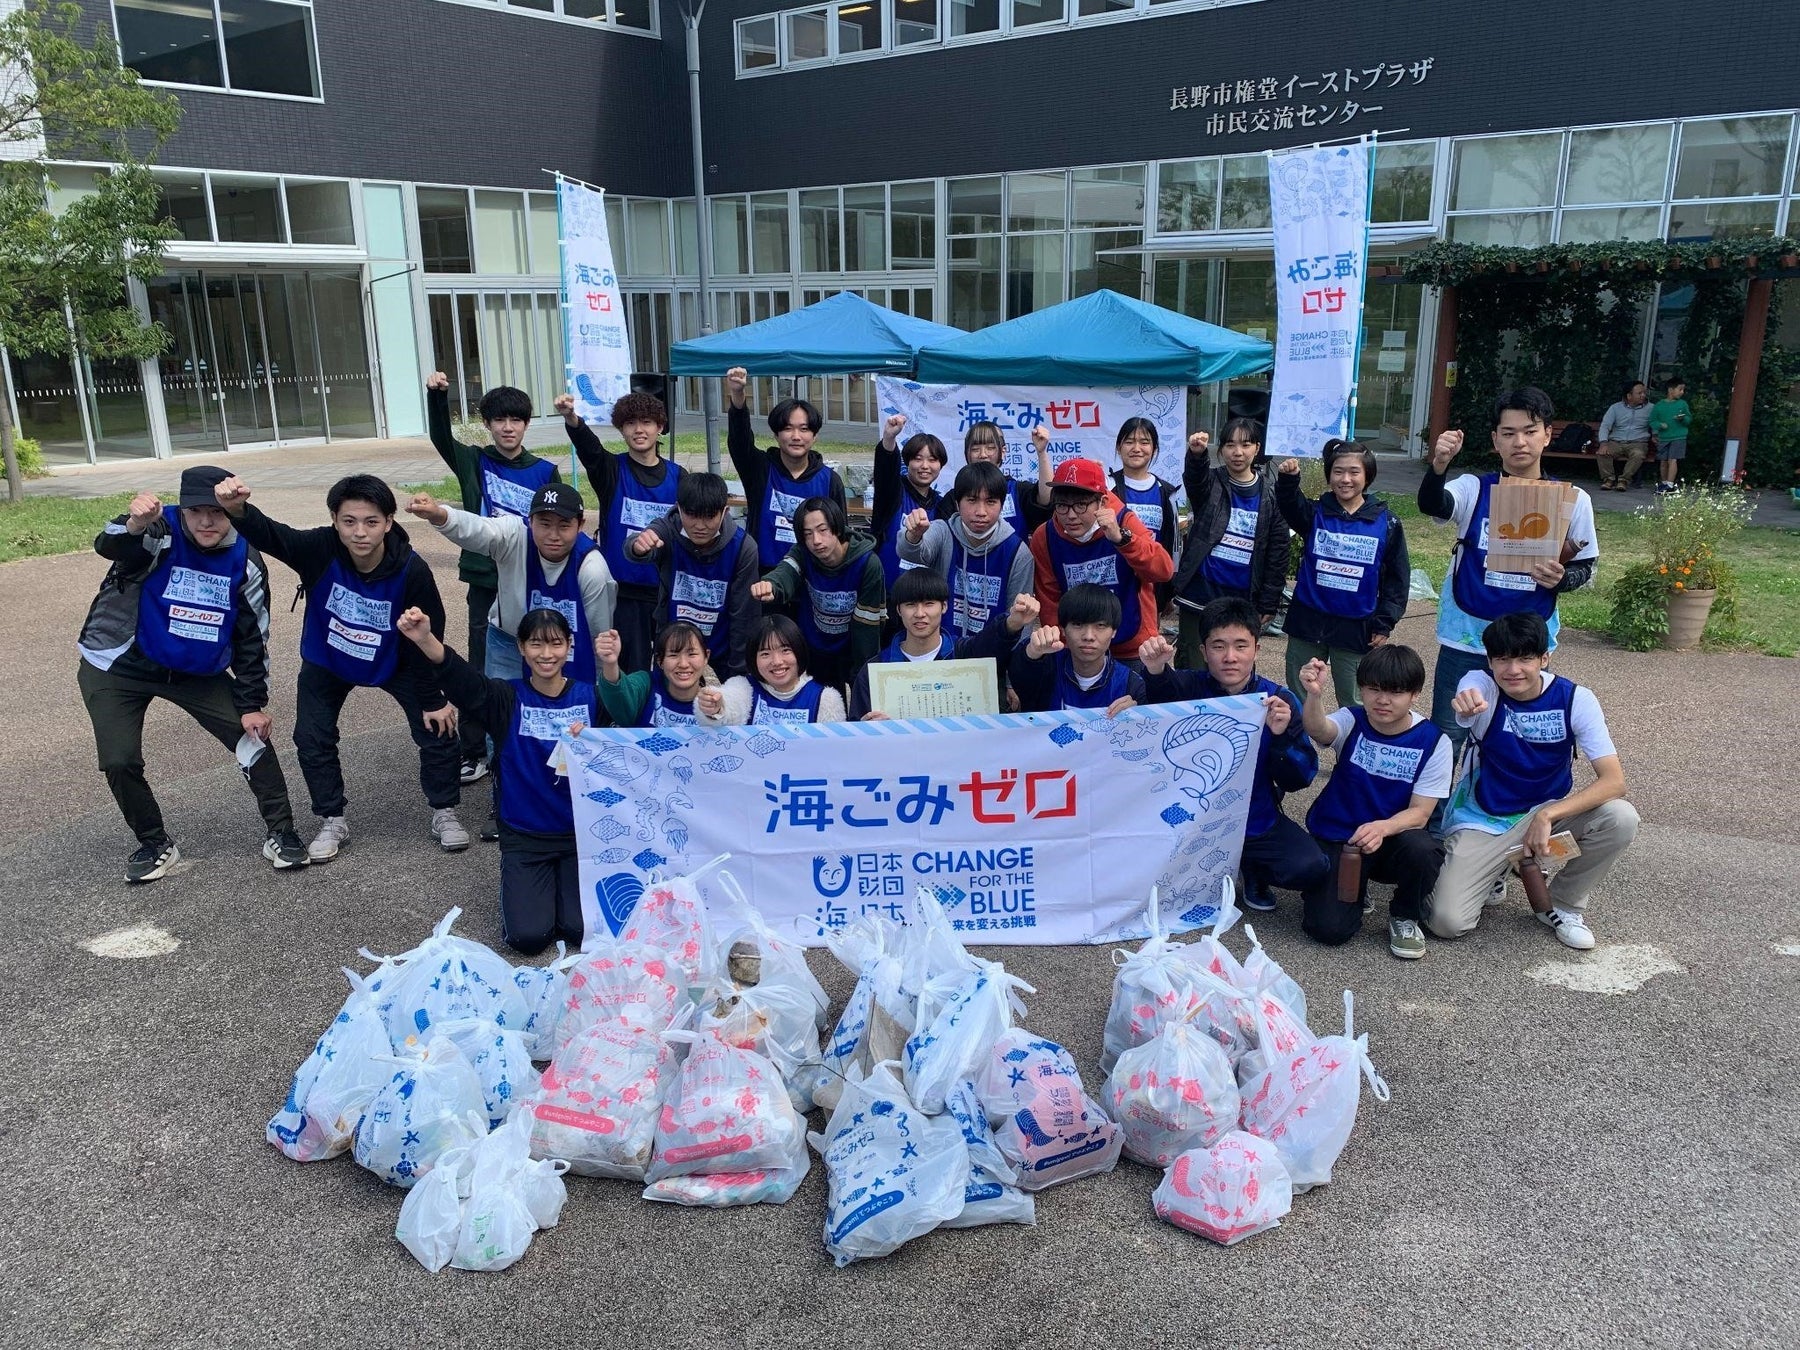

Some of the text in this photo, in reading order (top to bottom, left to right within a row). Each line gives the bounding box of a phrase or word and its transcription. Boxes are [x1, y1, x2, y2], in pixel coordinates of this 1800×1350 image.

[1169, 57, 1435, 111] 長野市権堂イーストプラザ
[1205, 100, 1384, 136] 市民交流センター
[575, 263, 615, 289] 海ごみ
[586, 291, 611, 312] ゼロ
[958, 400, 1101, 433] 海ごみゼロ
[1026, 442, 1081, 454] CANGE
[1342, 536, 1377, 546] CHANGE
[1355, 548, 1375, 557] BLUE
[356, 596, 389, 611] CHANGE
[548, 707, 587, 720] CHANGE
[772, 710, 807, 720] CHANGE
[1520, 712, 1563, 723] CHANGE
[1540, 726, 1564, 737] BLUE
[764, 768, 1077, 833] 海ごみゼロ
[857, 853, 903, 873] 日本
[912, 847, 1034, 874] CHANGE
[858, 876, 905, 896] 財団
[970, 872, 1035, 889] FOR THE
[970, 889, 1036, 915] BLUE
